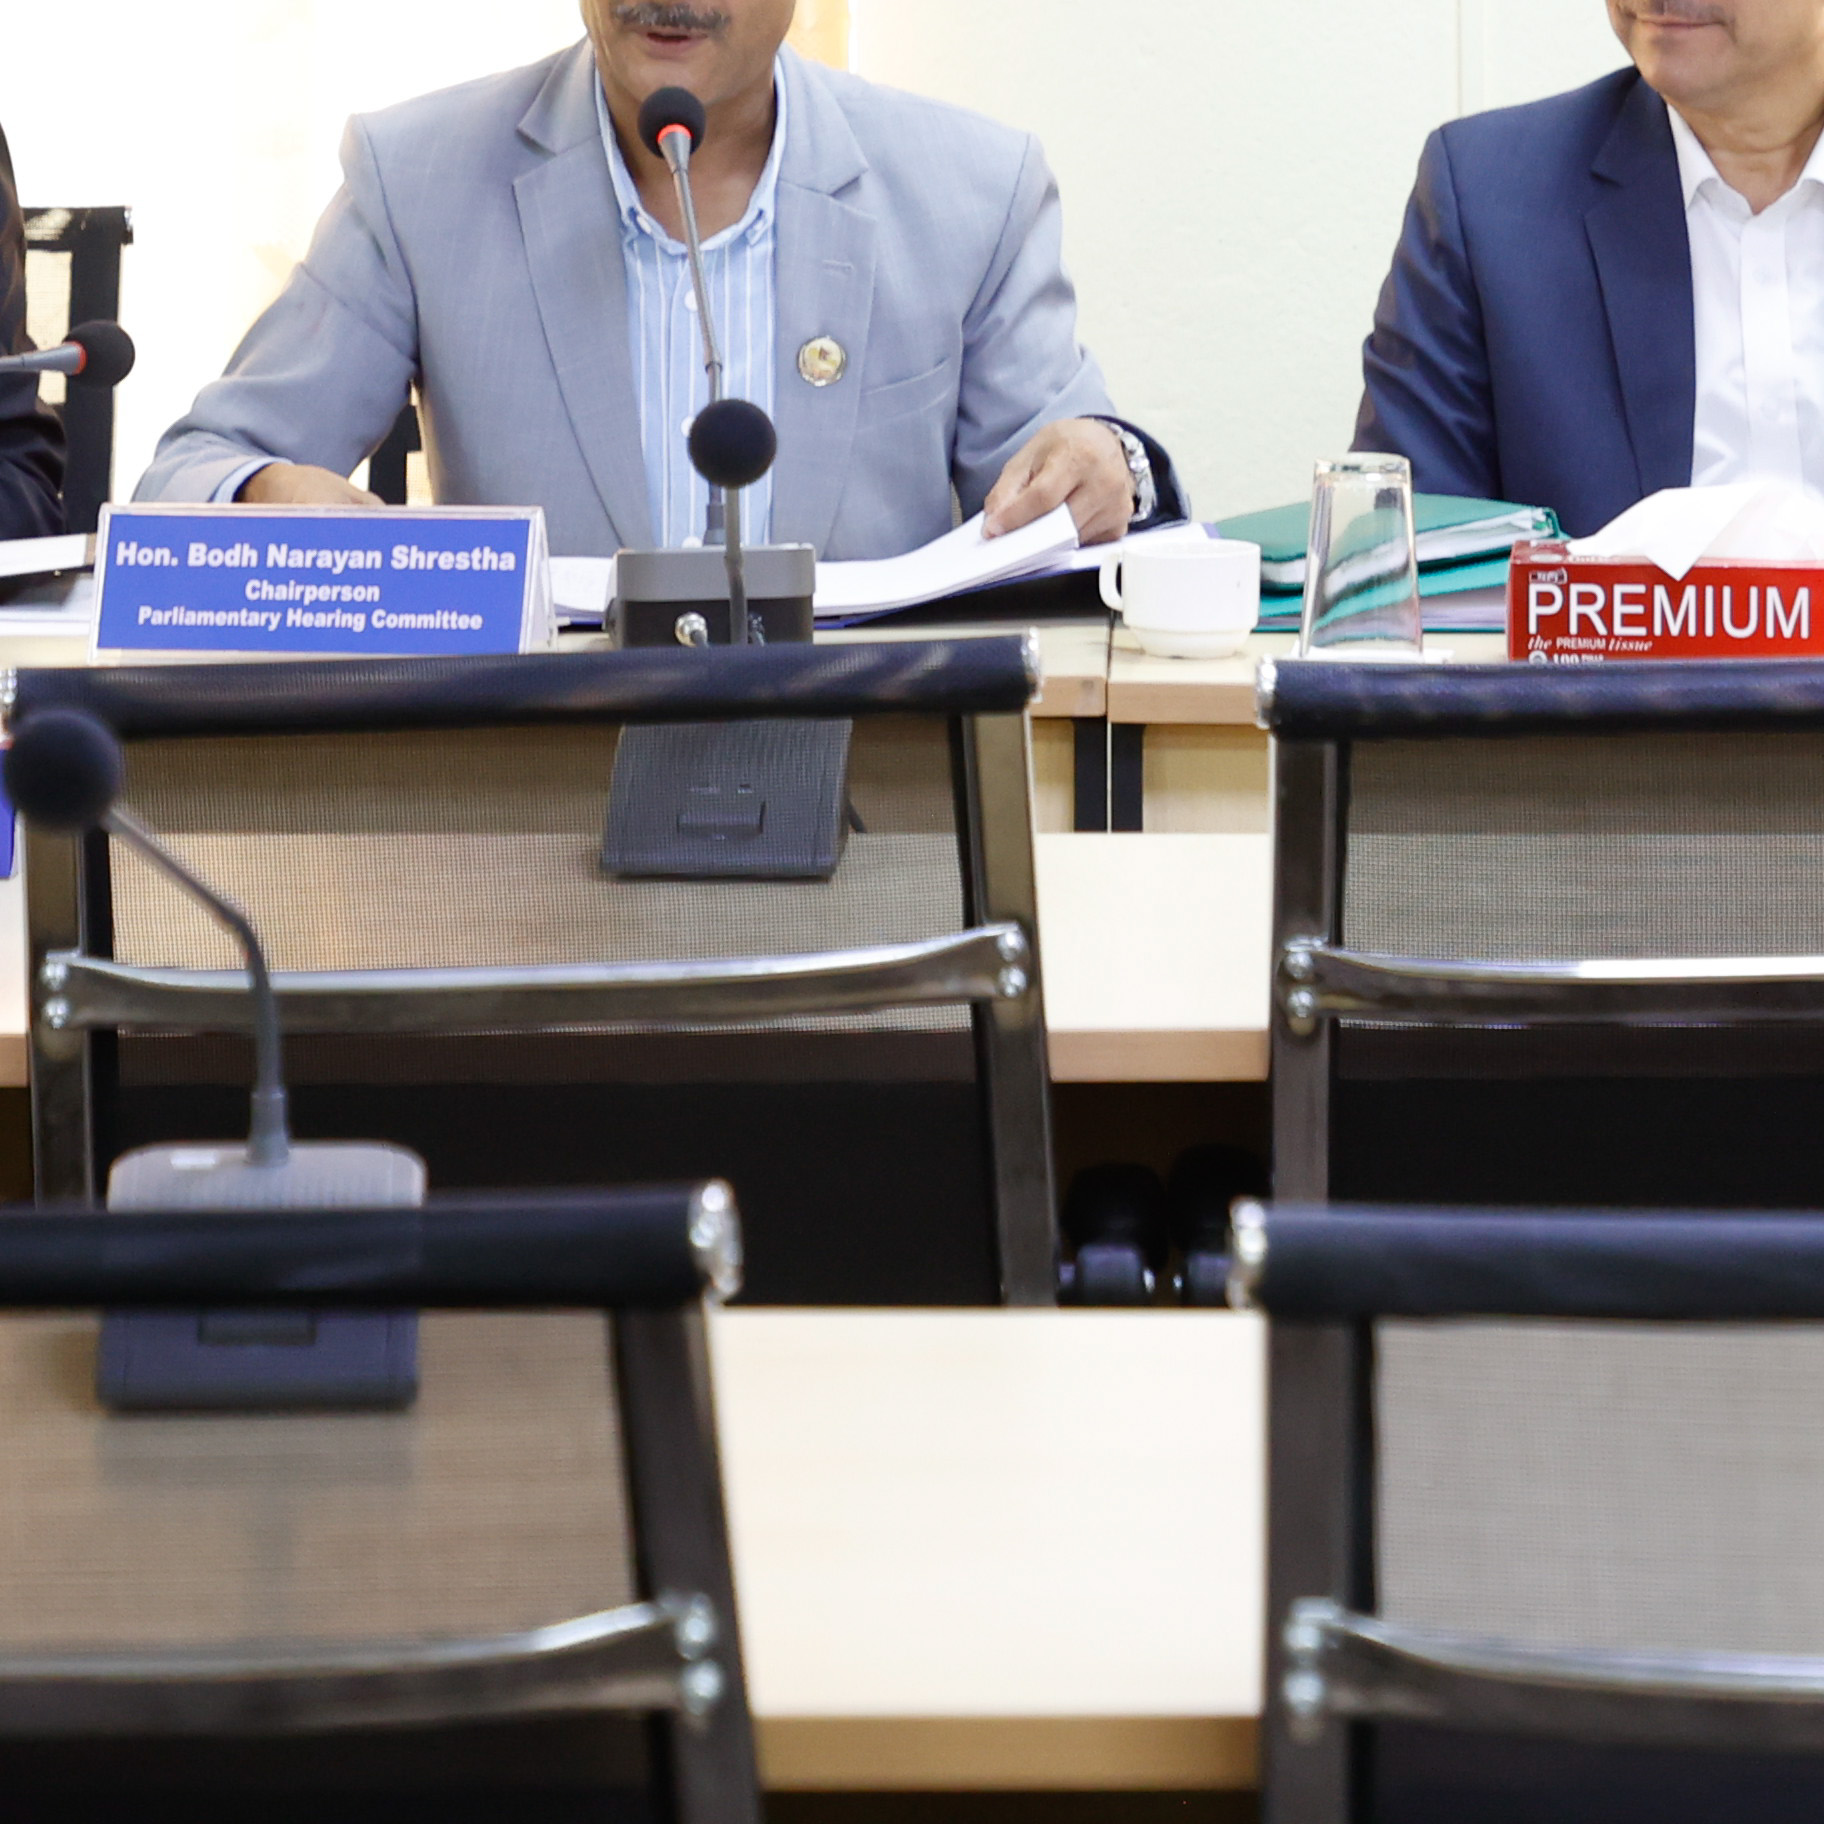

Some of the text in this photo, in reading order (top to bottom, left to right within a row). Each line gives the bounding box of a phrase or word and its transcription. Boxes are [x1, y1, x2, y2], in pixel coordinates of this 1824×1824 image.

[116, 541, 516, 574] Hon. Bodh Narayan Shrestha
[245, 579, 380, 605] Chairperson
[138, 606, 483, 633] Parliamentary Hearing Committee
[1528, 583, 1810, 639] PREMIUM
[1528, 635, 1653, 651] the PREMIUM tissue
